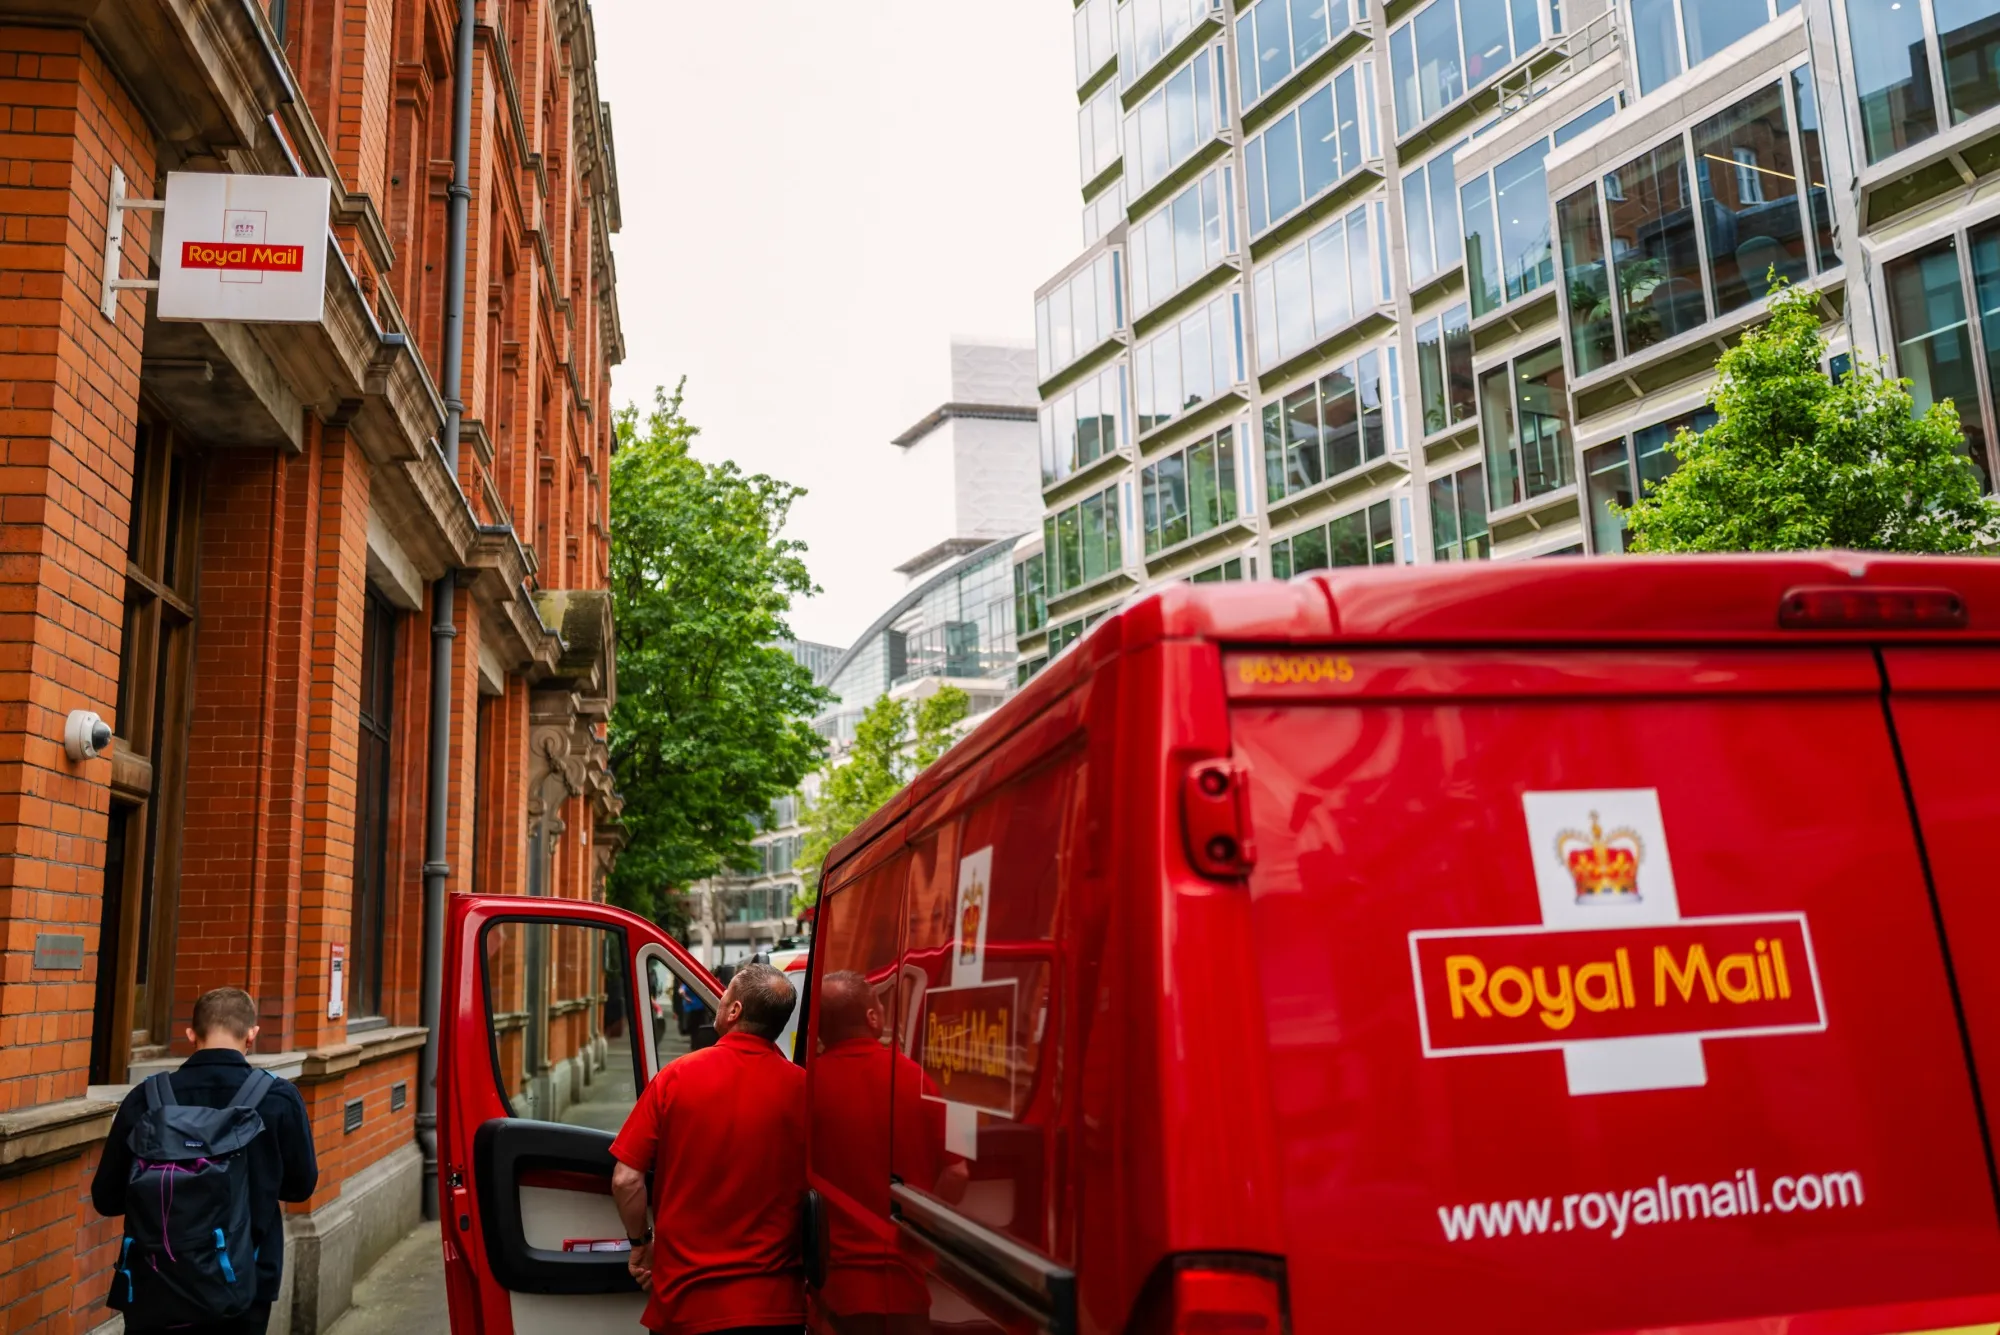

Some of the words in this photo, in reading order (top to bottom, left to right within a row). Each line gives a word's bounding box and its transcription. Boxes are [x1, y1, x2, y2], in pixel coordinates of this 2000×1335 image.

[189, 245, 247, 267] Royal
[252, 247, 297, 265] Mail
[1445, 947, 1635, 1030] Royal
[1653, 938, 1791, 1006] Mail
[927, 1011, 967, 1085] Royal
[968, 1008, 1007, 1077] Mail
[1438, 1168, 1865, 1242] www.royalmail.com
